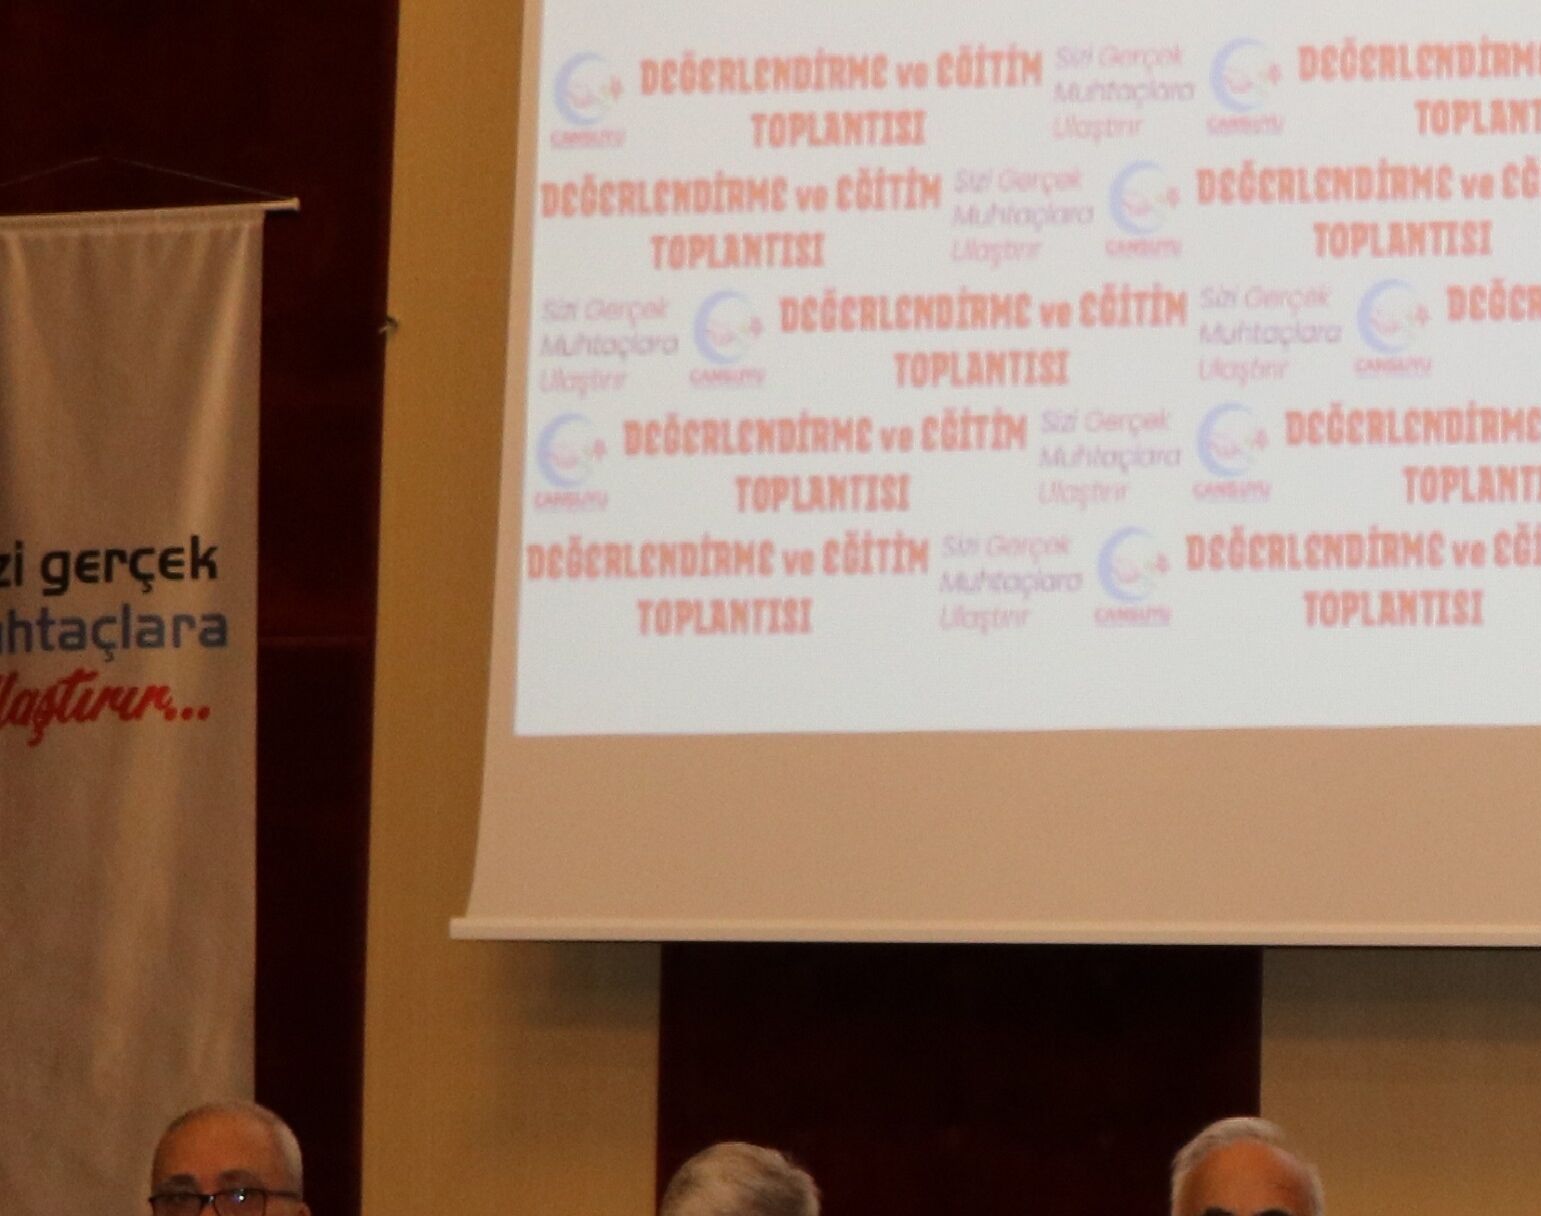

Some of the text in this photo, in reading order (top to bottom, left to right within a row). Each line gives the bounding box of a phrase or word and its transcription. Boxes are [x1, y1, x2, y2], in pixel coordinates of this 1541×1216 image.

[895, 61, 930, 89] ve
[751, 108, 926, 148] TOPLANTISI
[794, 184, 830, 212] ve
[1460, 173, 1496, 199] ve
[650, 230, 825, 270] TOPLANTISI
[1313, 218, 1492, 257] TOPLANTISI
[1039, 300, 1073, 328] ve
[893, 348, 1069, 388] TOPLANTISI
[879, 426, 914, 452] ve
[735, 473, 910, 512] TOPLANTISI
[41, 535, 218, 597] gerçek
[782, 549, 815, 576] ve
[1452, 539, 1487, 566] ve
[636, 597, 812, 635] TOPLANTISI
[1304, 589, 1483, 626] TOPLANTISI
[0, 603, 227, 661] htaçlara
